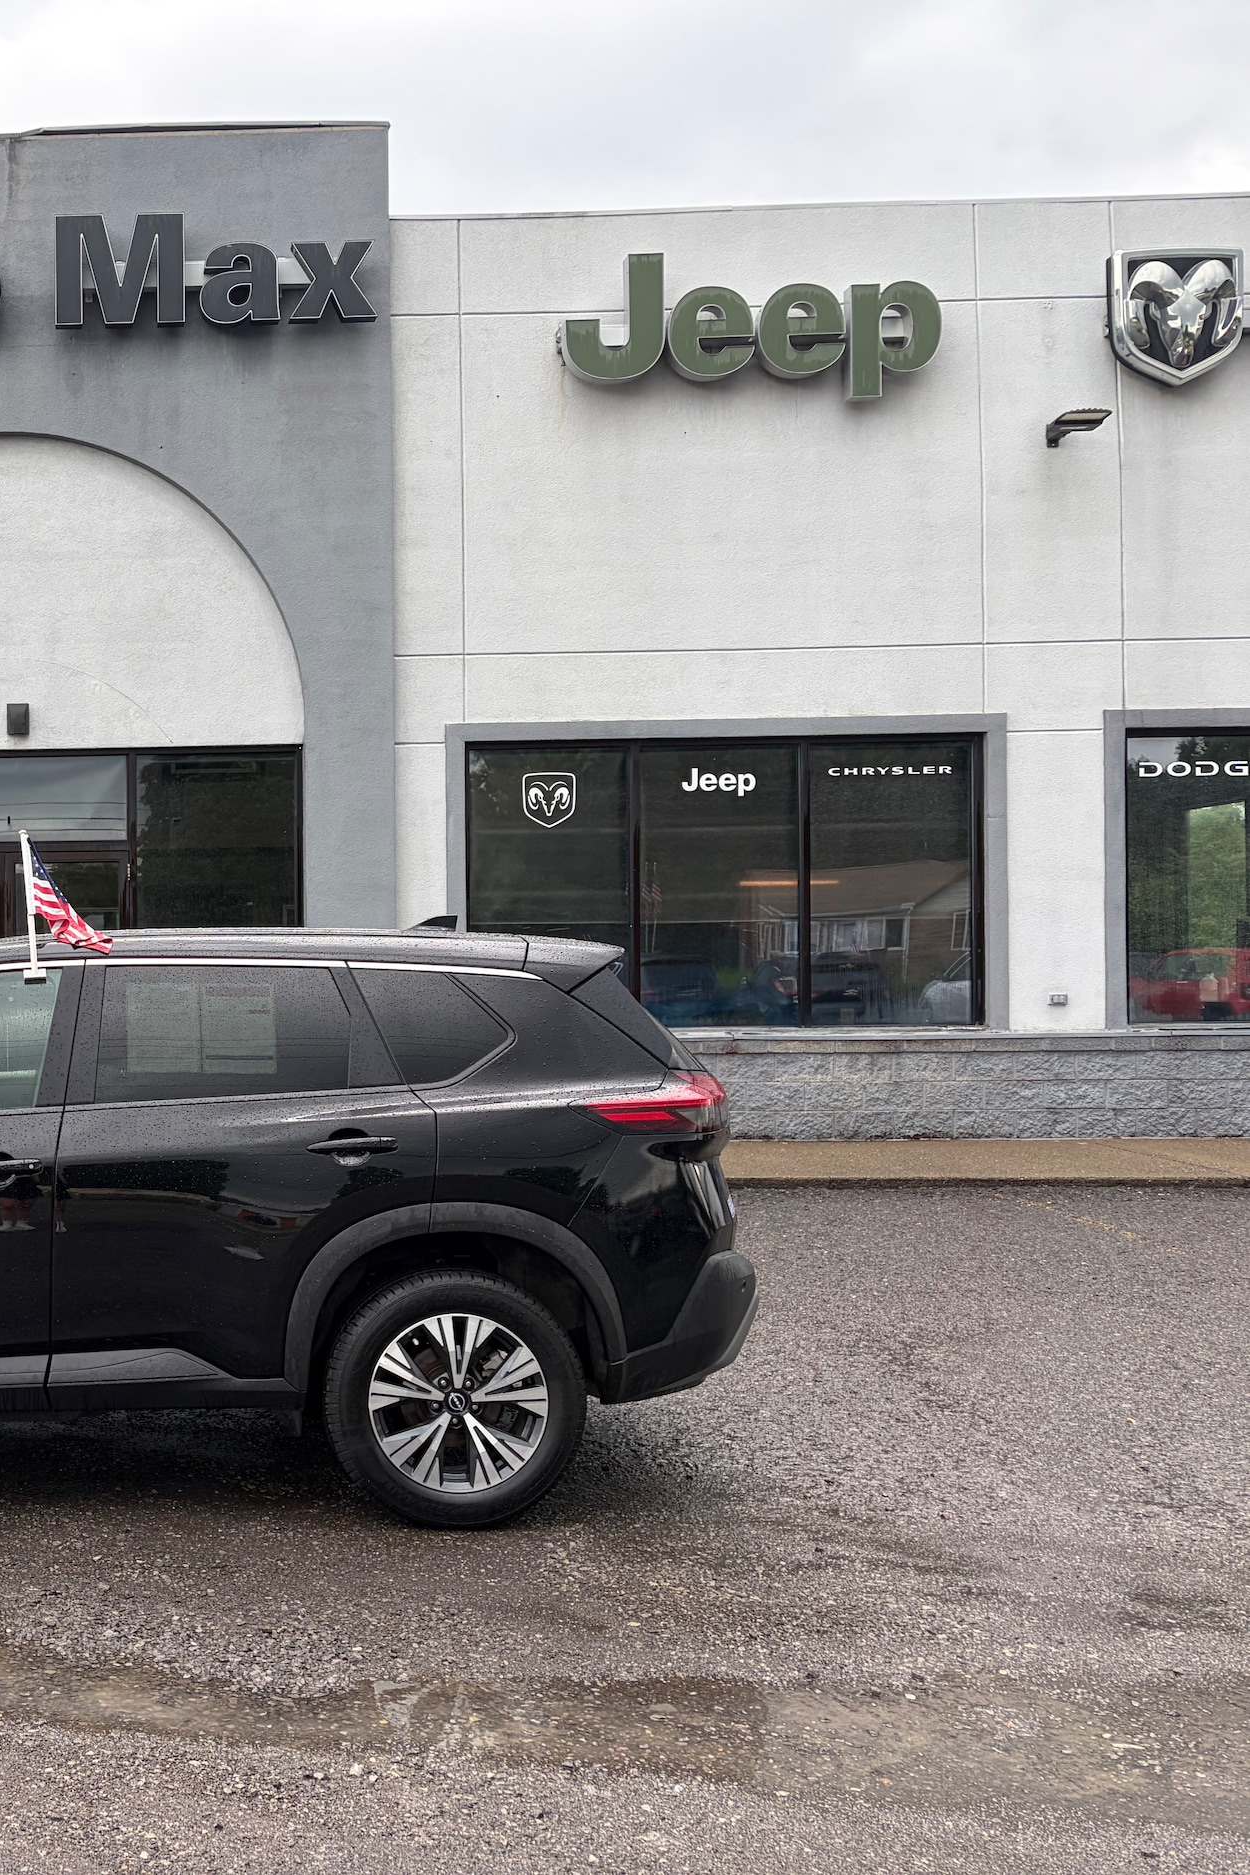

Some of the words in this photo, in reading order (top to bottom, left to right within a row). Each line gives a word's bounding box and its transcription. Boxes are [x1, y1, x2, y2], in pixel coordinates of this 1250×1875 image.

[54, 212, 378, 330] Max
[564, 252, 943, 399] Jeep
[681, 767, 757, 797] Jeep
[827, 765, 953, 777] CHRYSLER
[1138, 760, 1250, 778] DODG
